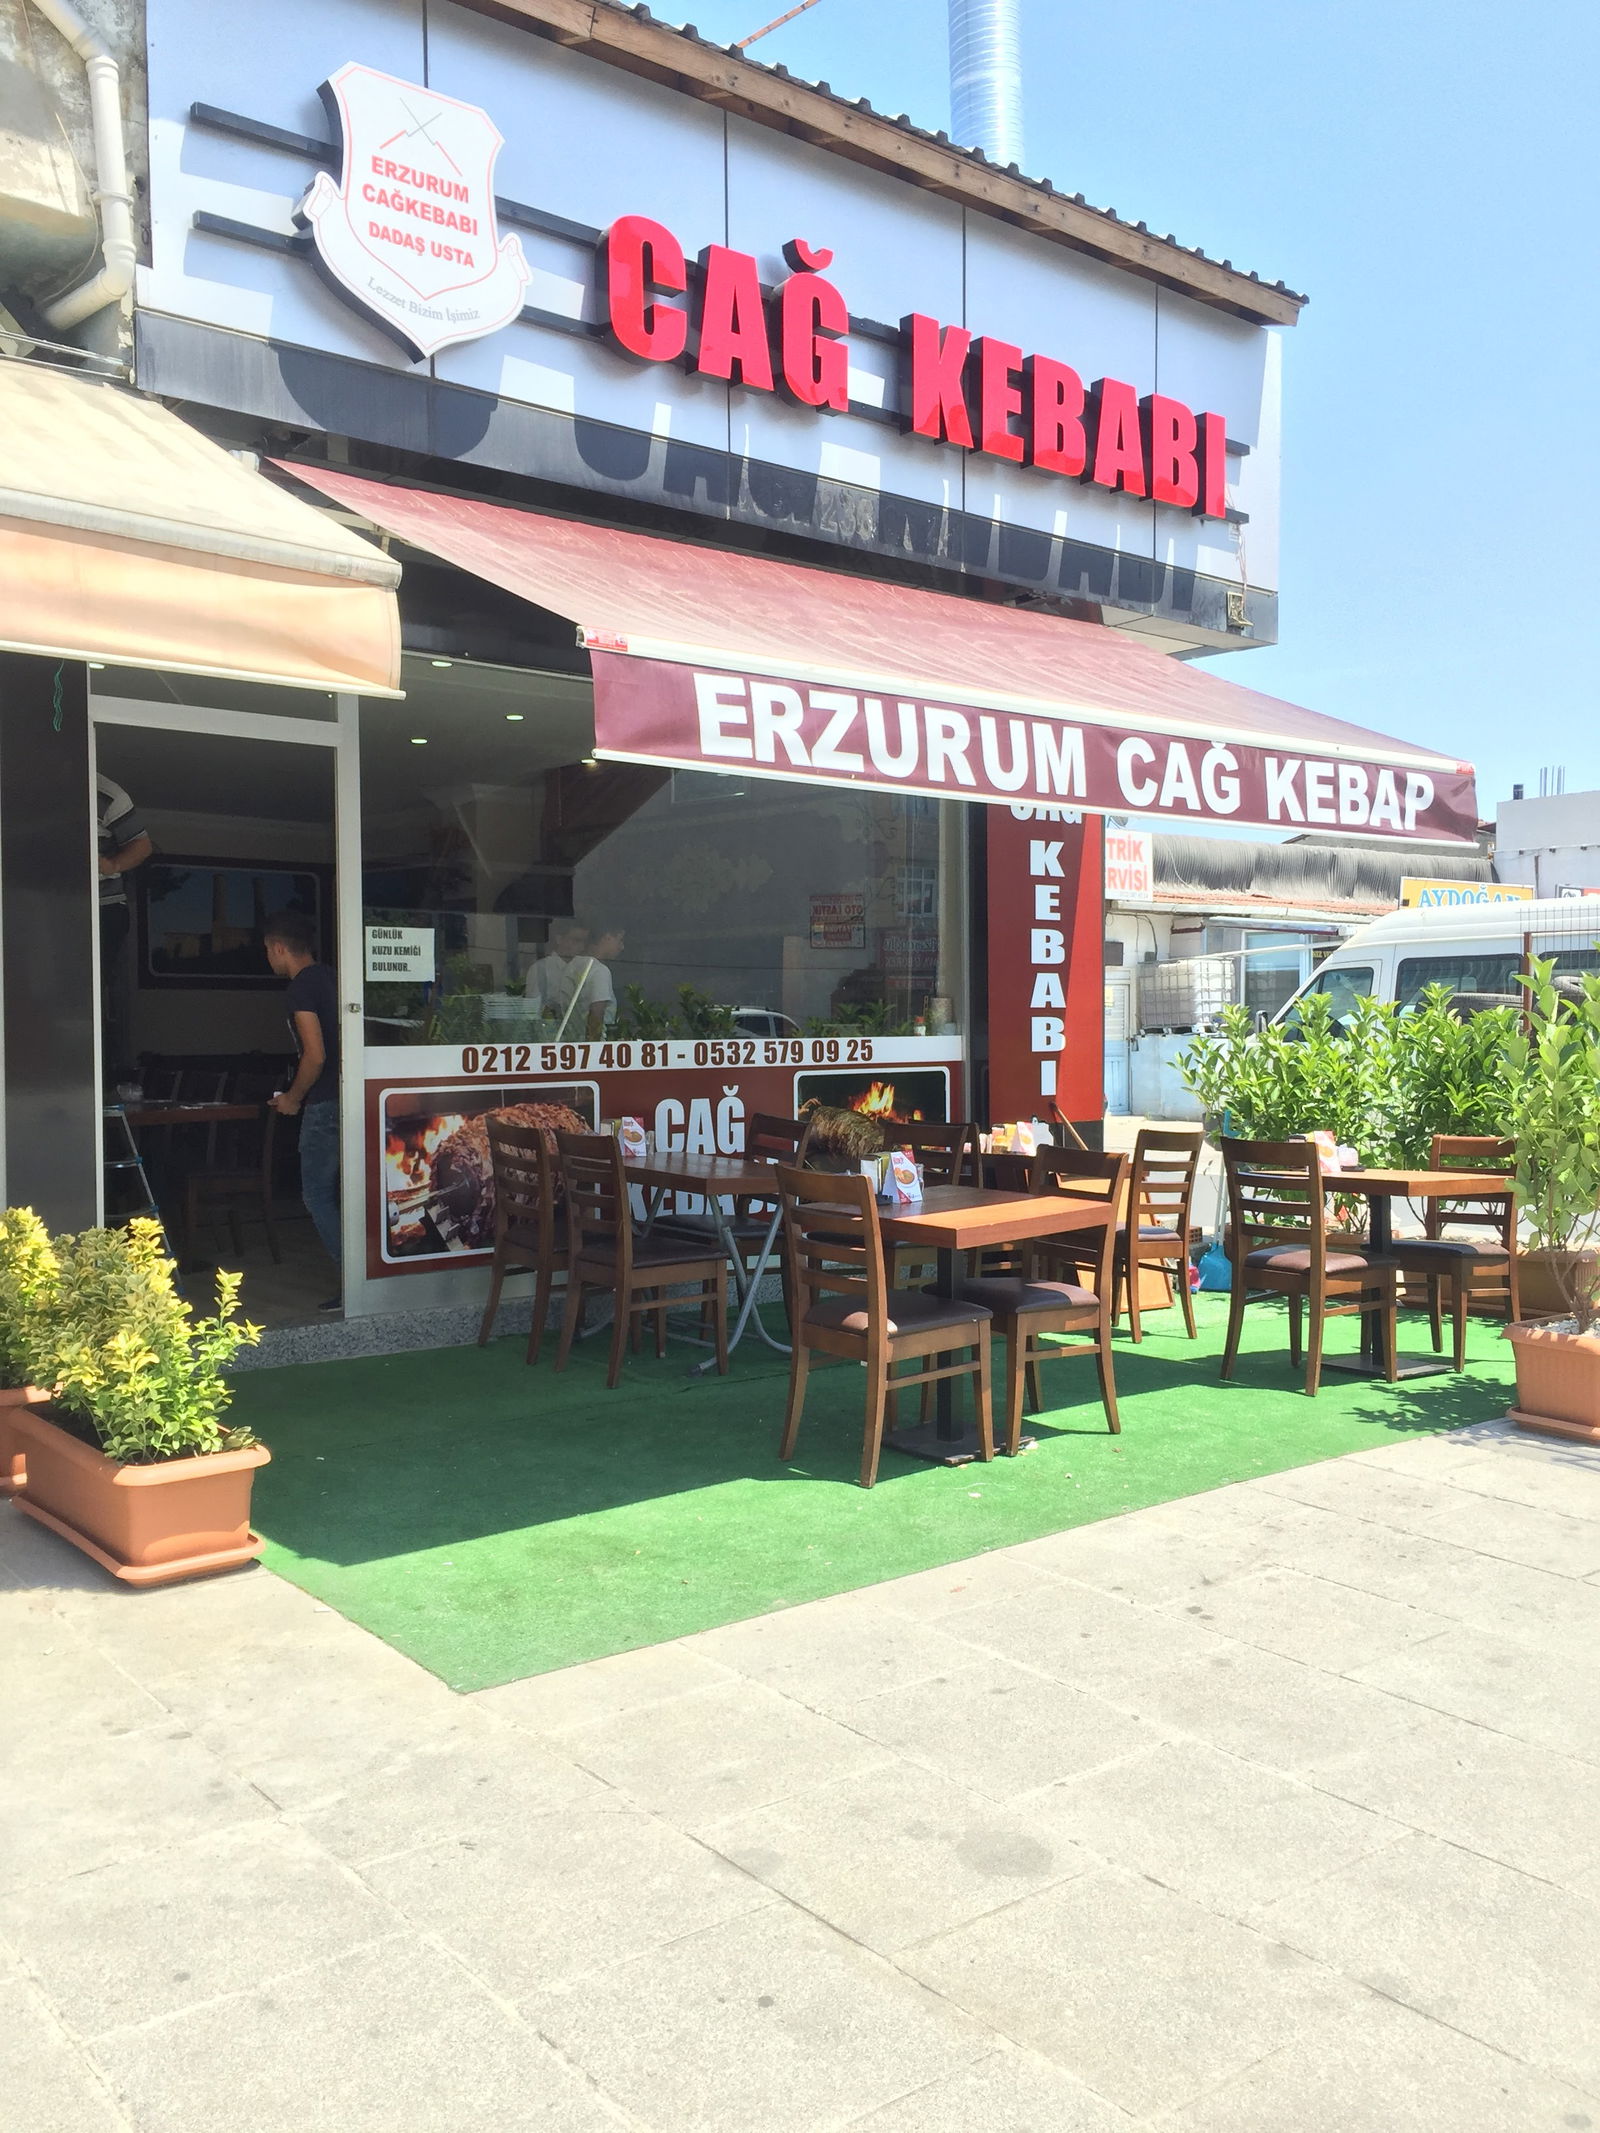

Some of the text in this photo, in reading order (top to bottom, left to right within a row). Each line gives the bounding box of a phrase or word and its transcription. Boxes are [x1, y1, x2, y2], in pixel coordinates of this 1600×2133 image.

[371, 155, 469, 203] ERZURUM
[362, 183, 478, 236] CAĞKEBABI
[369, 221, 475, 268] DADAŞ USTA
[367, 276, 406, 310] Lezzet
[409, 300, 444, 321] Bizim
[602, 215, 850, 414] CAĞ
[908, 313, 1226, 518] KEBABI
[693, 671, 1434, 832] ERZURUM CAĞ KEBAP
[372, 928, 403, 940] GÜNLÜK
[372, 944, 421, 956] KUZU KEMİĞİ
[1029, 840, 1066, 1096] KEBABI
[461, 1045, 530, 1074] 0212
[541, 1043, 591, 1071] 597
[598, 1042, 632, 1069] 40
[641, 1041, 669, 1068] 81
[694, 1040, 757, 1066] 0532
[764, 1039, 803, 1064] 579
[811, 1039, 840, 1063] 09
[847, 1038, 873, 1062] 25
[655, 1084, 745, 1155] CAĞ
